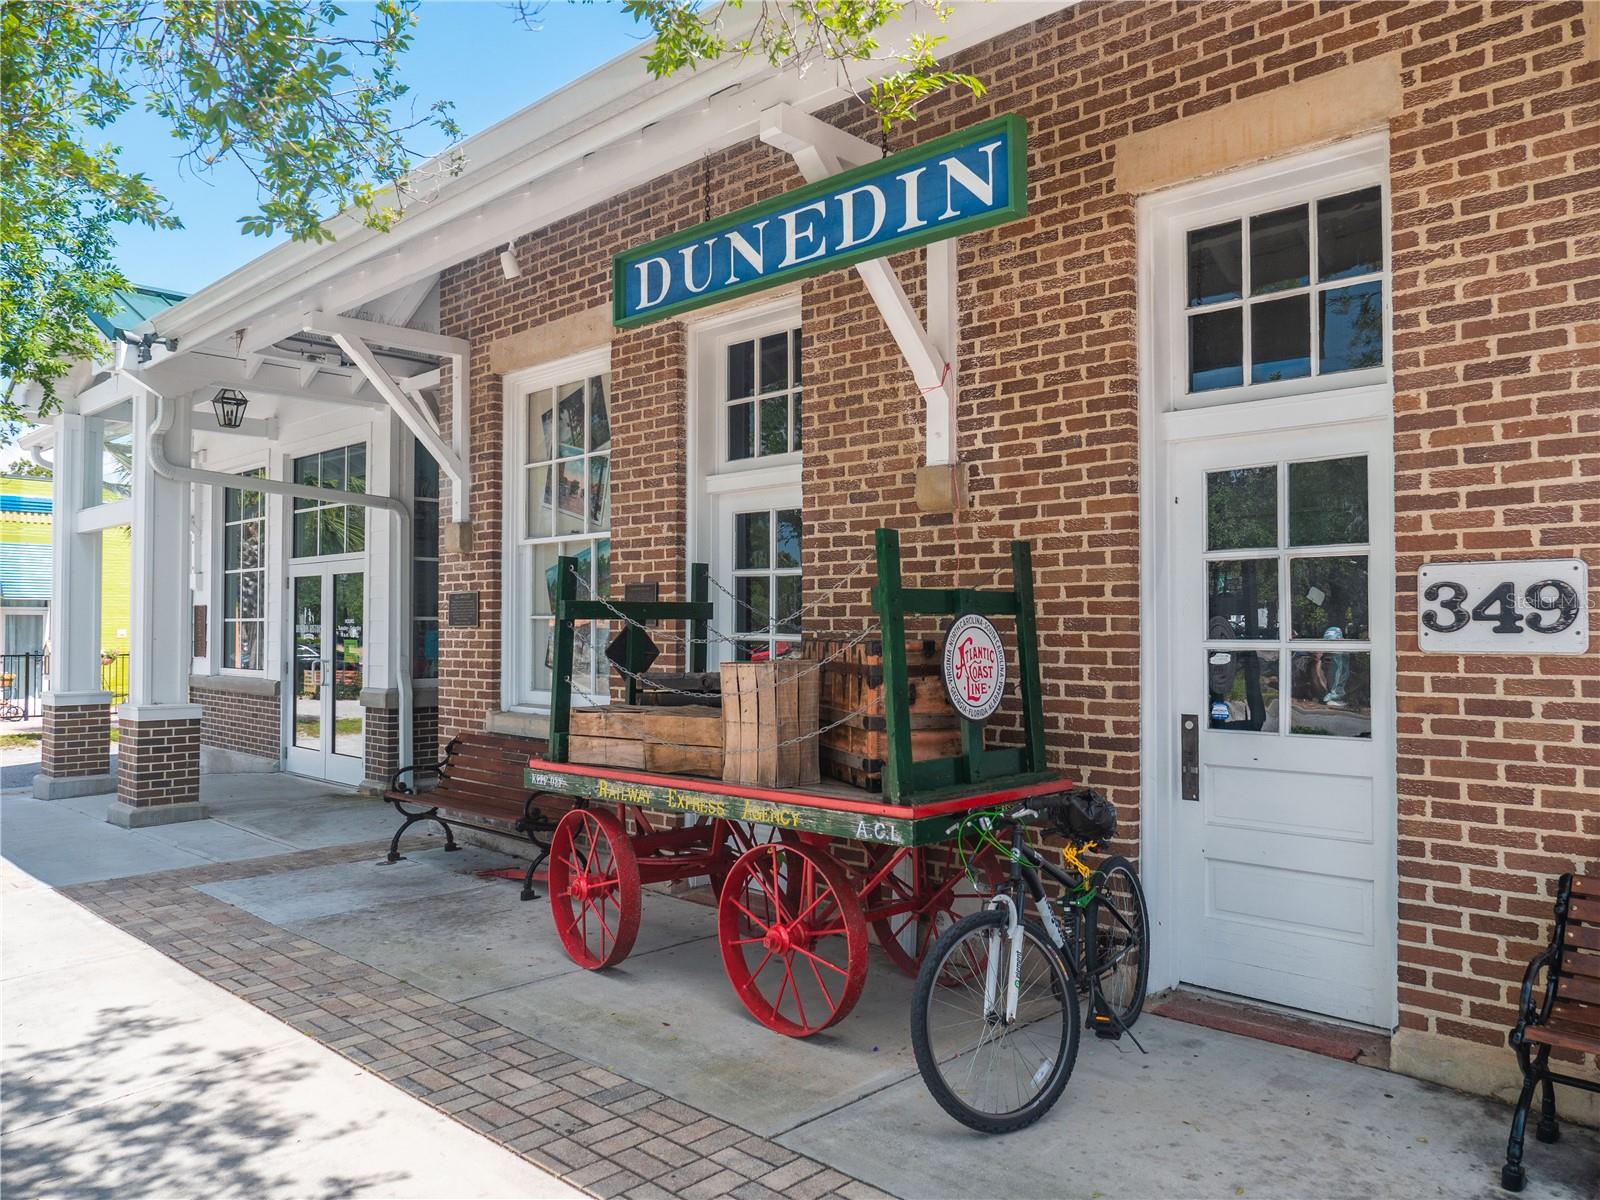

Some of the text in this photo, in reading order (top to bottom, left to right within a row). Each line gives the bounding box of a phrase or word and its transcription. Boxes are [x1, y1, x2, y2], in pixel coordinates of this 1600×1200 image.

[634, 140, 1003, 312] DUNEDIN
[1421, 578, 1581, 635] 349
[956, 636, 995, 680] ATLANTIC
[968, 660, 994, 683] COAST
[967, 676, 988, 702] LINE
[598, 779, 800, 827] RAILWAY EXPRESS AGENCY
